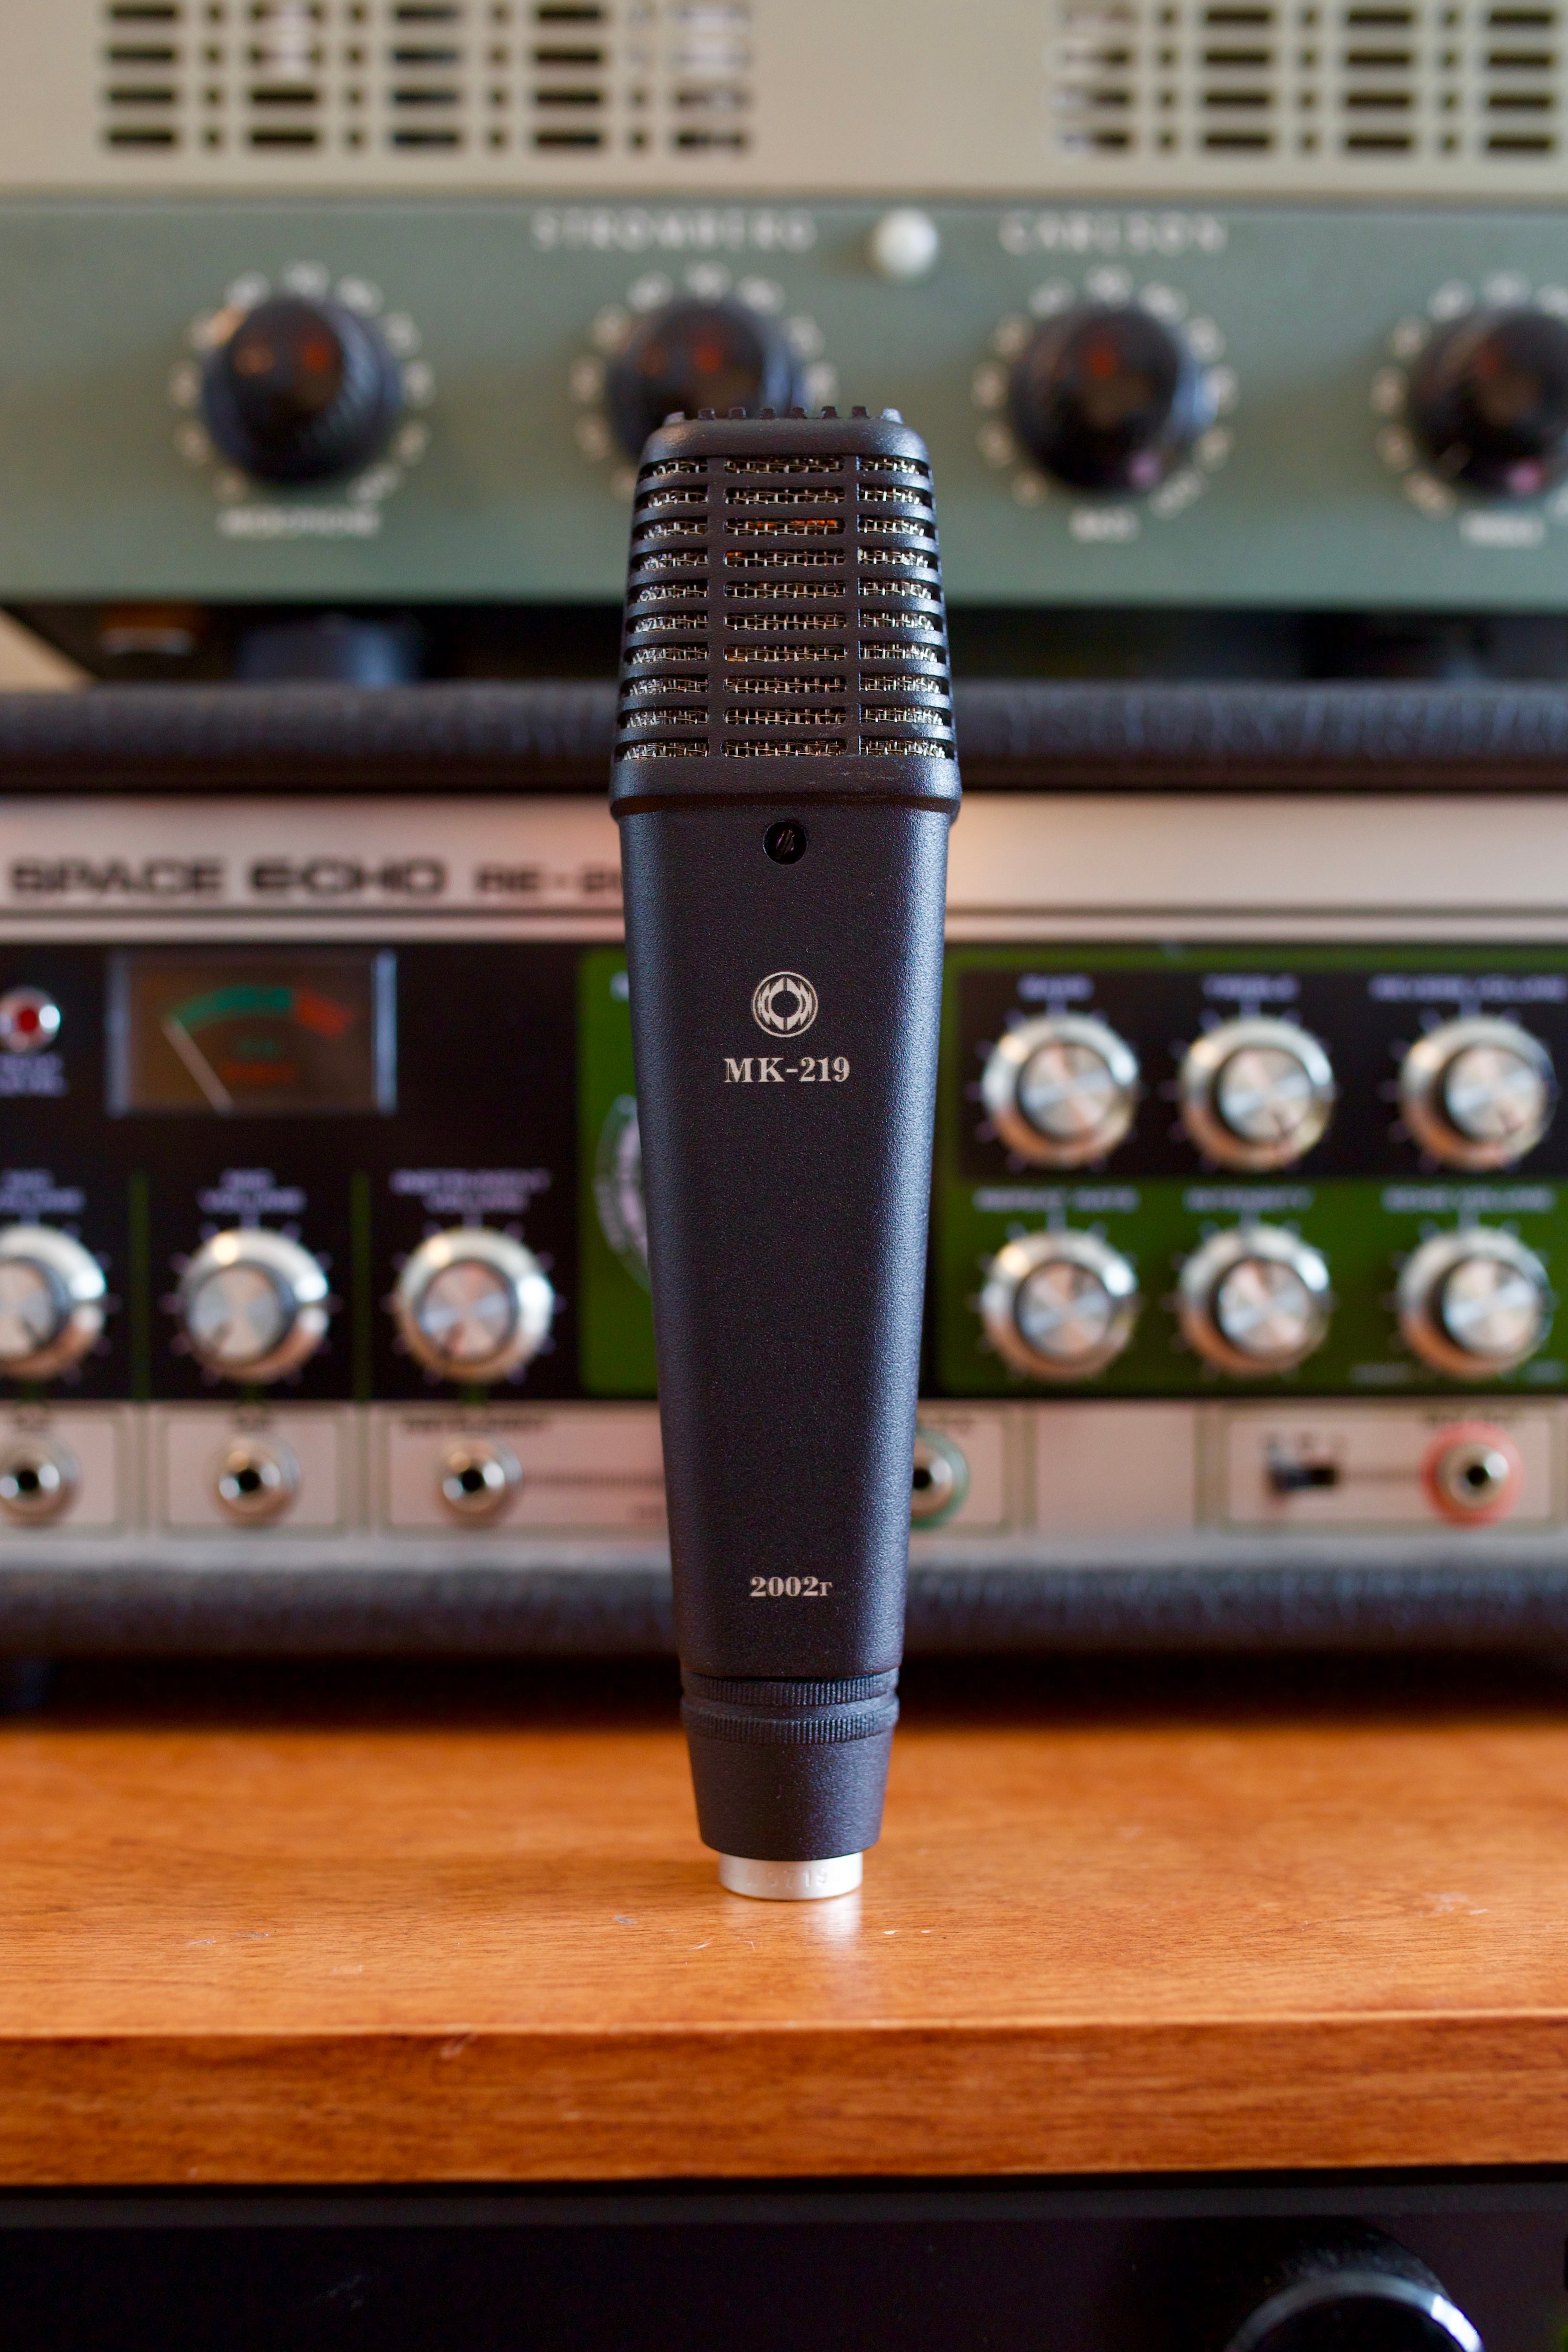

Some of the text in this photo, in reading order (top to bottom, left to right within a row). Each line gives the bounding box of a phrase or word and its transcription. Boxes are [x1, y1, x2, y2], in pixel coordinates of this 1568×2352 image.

[11, 857, 222, 897] SPACE
[249, 857, 449, 898] ECHO
[724, 1056, 851, 1083] MK-219
